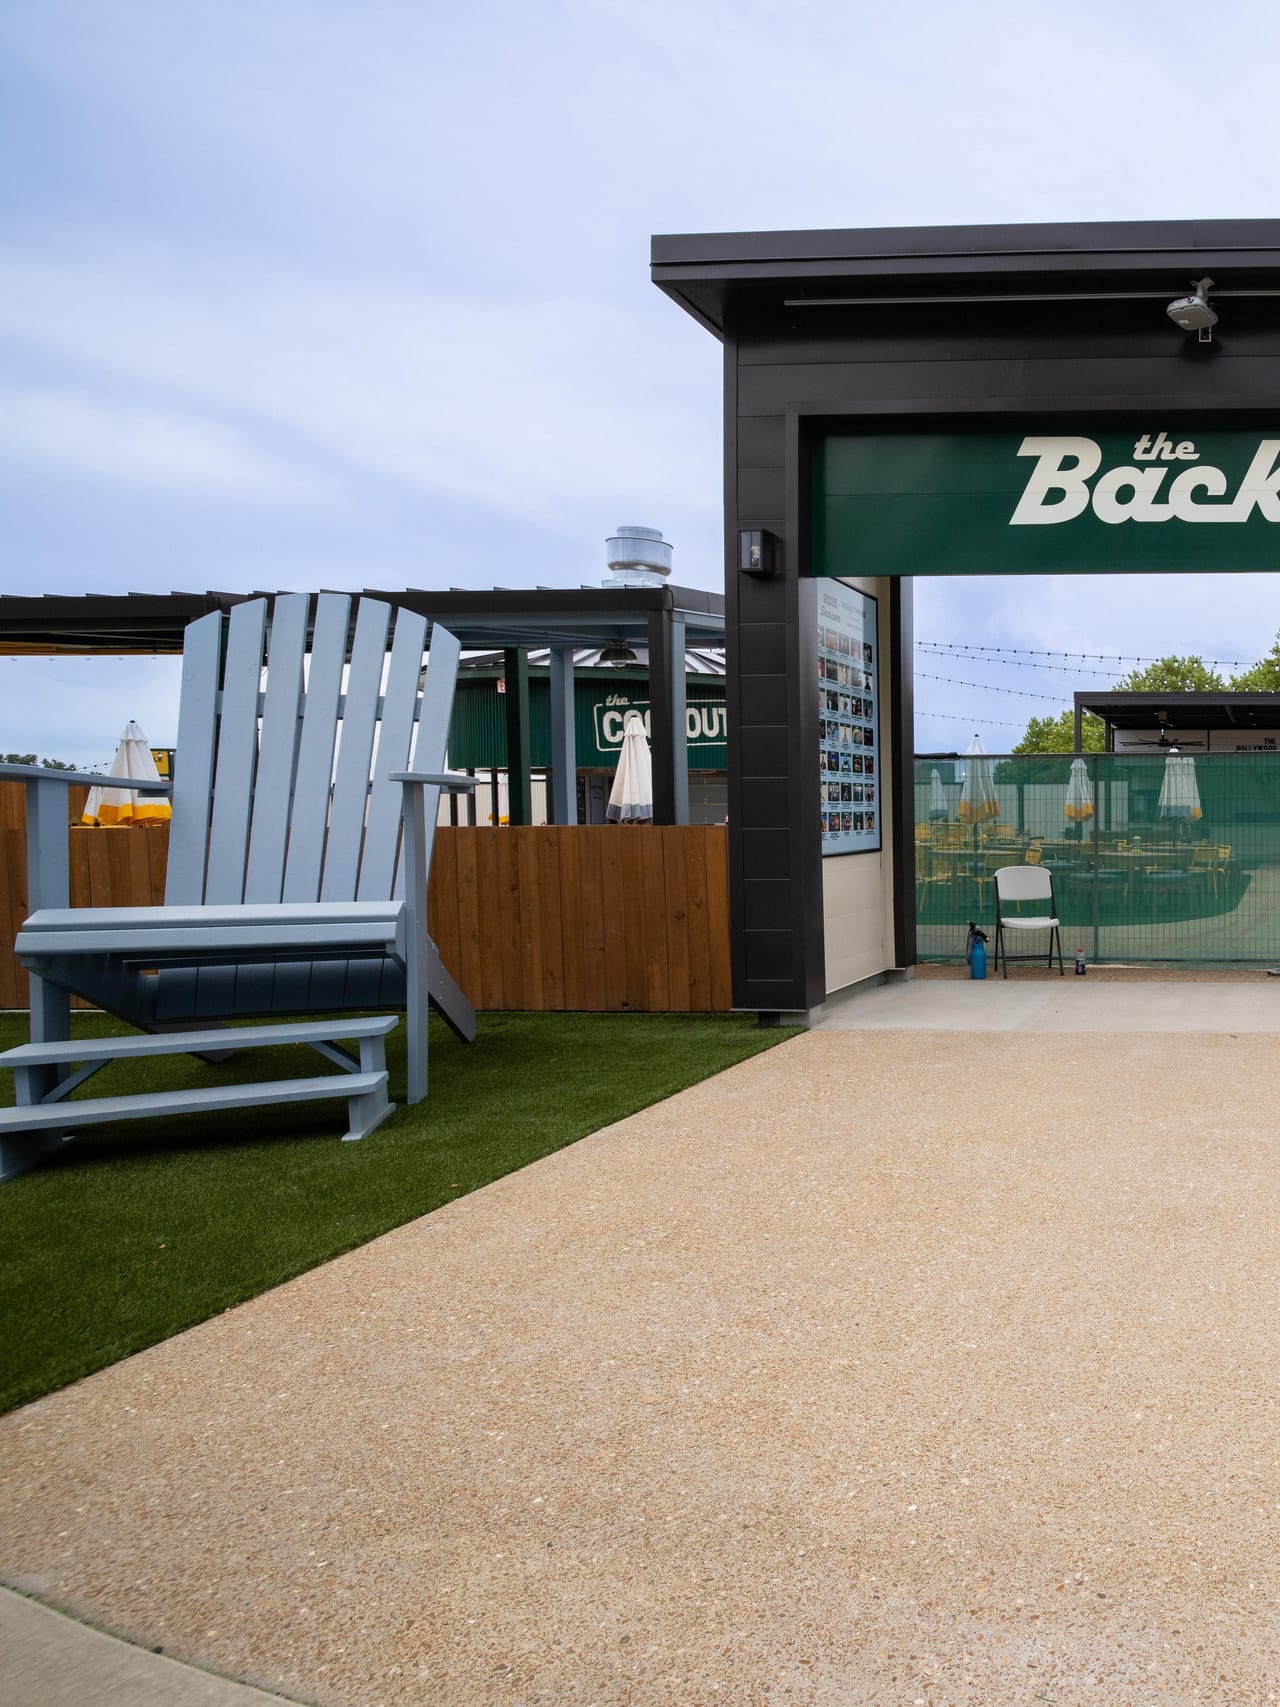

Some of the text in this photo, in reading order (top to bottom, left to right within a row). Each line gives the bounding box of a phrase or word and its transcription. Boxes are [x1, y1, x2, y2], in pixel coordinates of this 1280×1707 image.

[1133, 432, 1200, 461] the
[605, 694, 630, 706] the
[602, 707, 728, 744] COOUT
[1263, 737, 1276, 745] THE
